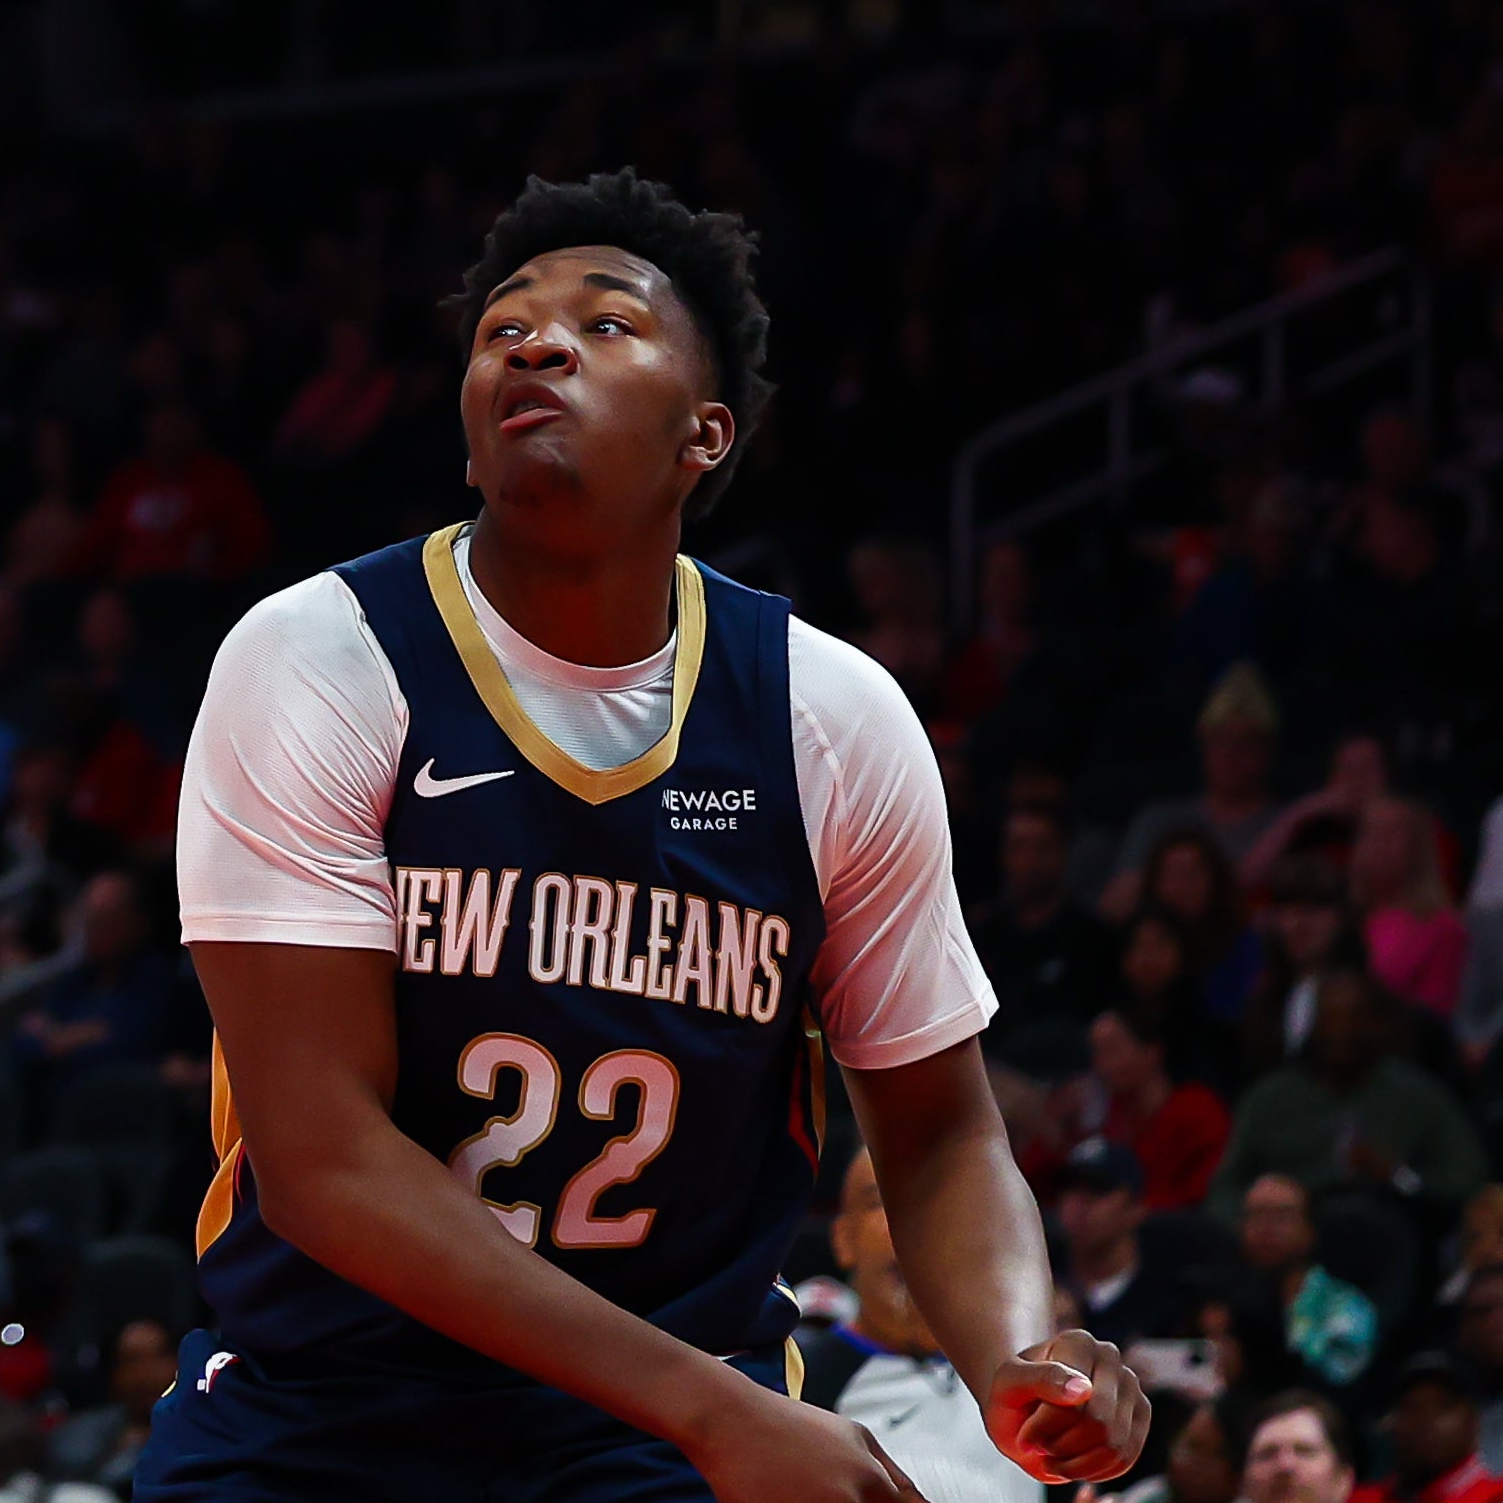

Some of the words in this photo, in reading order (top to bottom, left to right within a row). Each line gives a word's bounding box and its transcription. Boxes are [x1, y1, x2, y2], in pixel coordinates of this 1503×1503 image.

[661, 788, 756, 811] NEWAGE
[670, 816, 738, 830] GARAGE
[527, 870, 790, 1024] ORLEANS
[447, 1032, 680, 1249] 22
